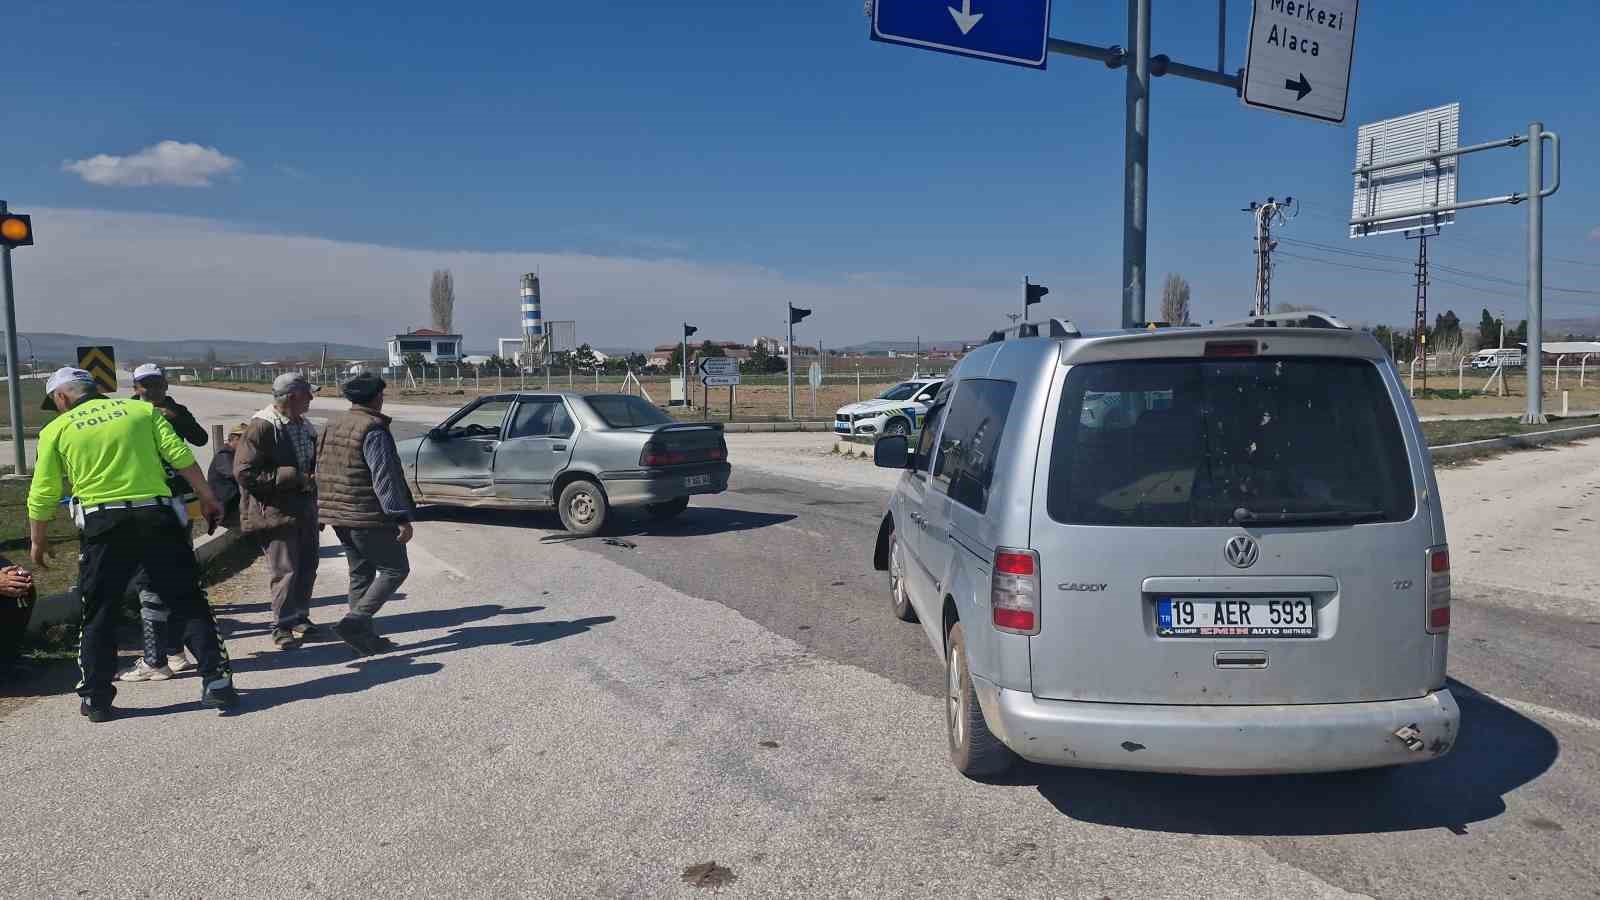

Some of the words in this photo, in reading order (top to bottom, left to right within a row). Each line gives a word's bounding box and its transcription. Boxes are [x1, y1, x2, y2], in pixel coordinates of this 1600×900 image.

[1267, 23, 1320, 57] Alaca
[1058, 583, 1108, 592] CADDY
[1172, 600, 1195, 626] 19
[1213, 600, 1252, 626] AER
[1269, 600, 1307, 626] 593
